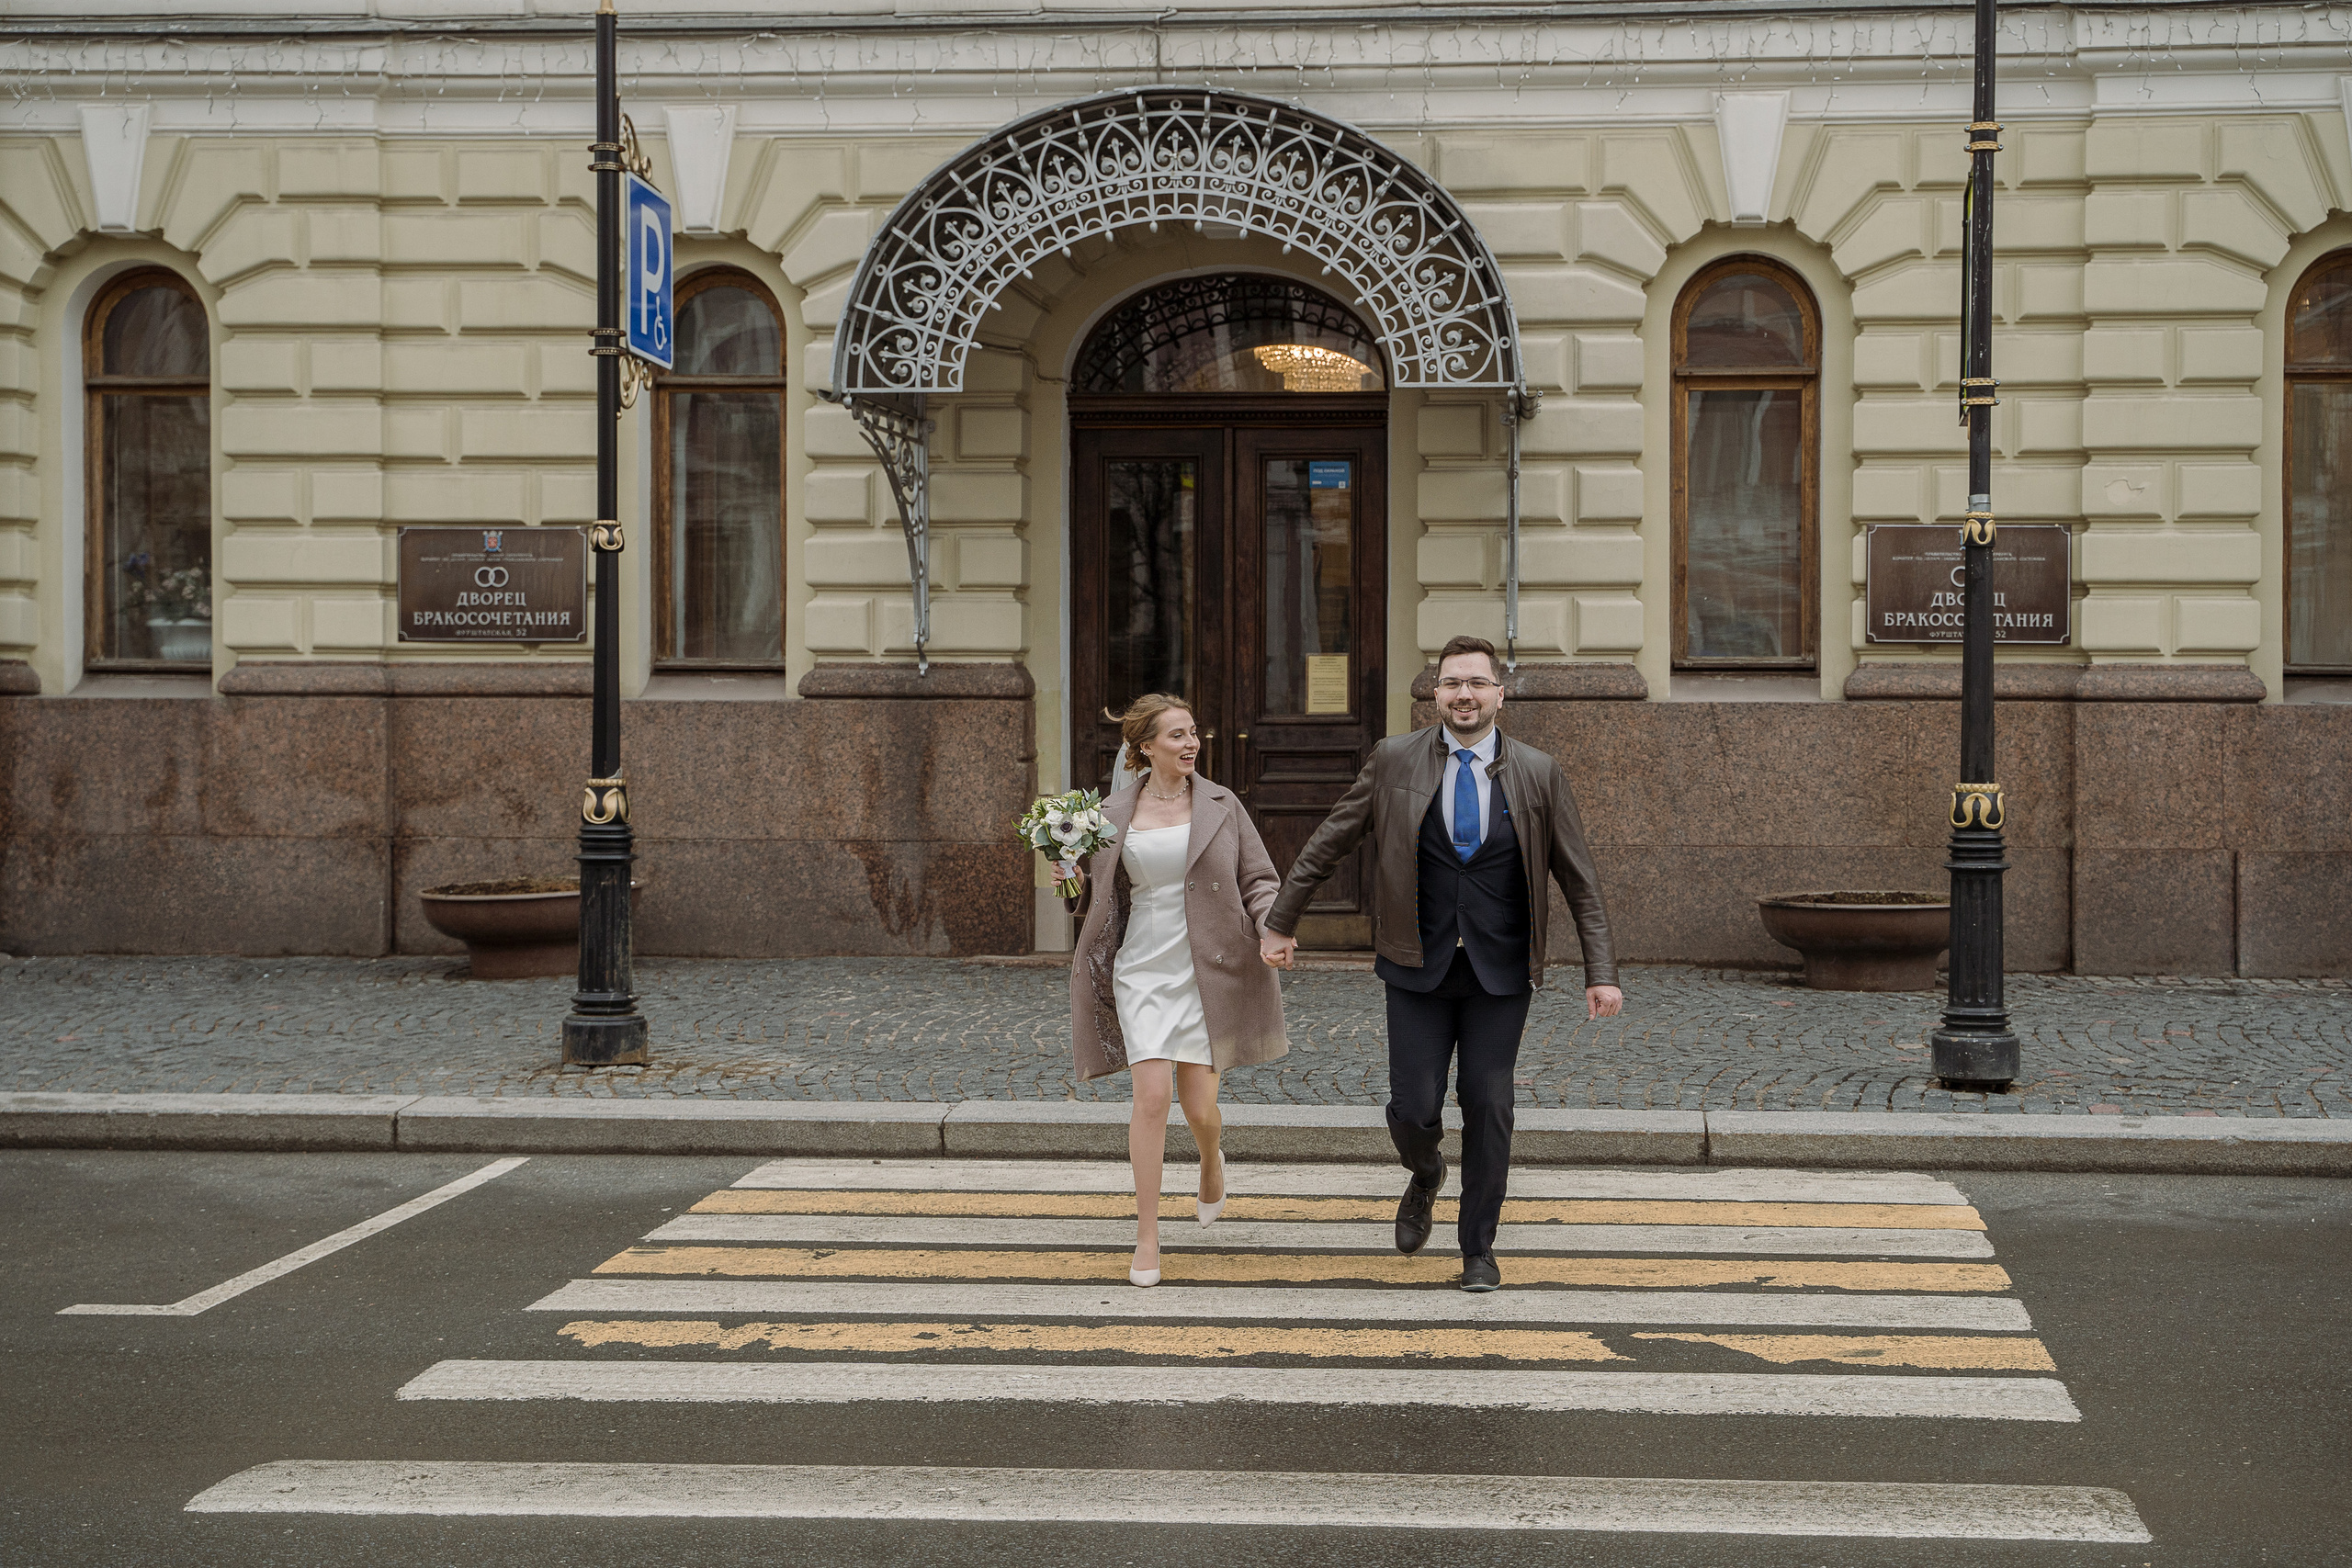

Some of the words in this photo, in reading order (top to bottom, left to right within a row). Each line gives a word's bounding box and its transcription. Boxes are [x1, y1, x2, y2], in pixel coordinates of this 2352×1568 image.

[641, 203, 665, 335] P
[456, 592, 527, 607] ДВОРЕЦ
[1930, 592, 2007, 608] ДВОЦ
[413, 611, 571, 626] БРАКОСОЧЕТАНИЯ
[1884, 612, 2054, 627] БРАКОСОТАНИЯ
[1995, 630, 2007, 638] 52
